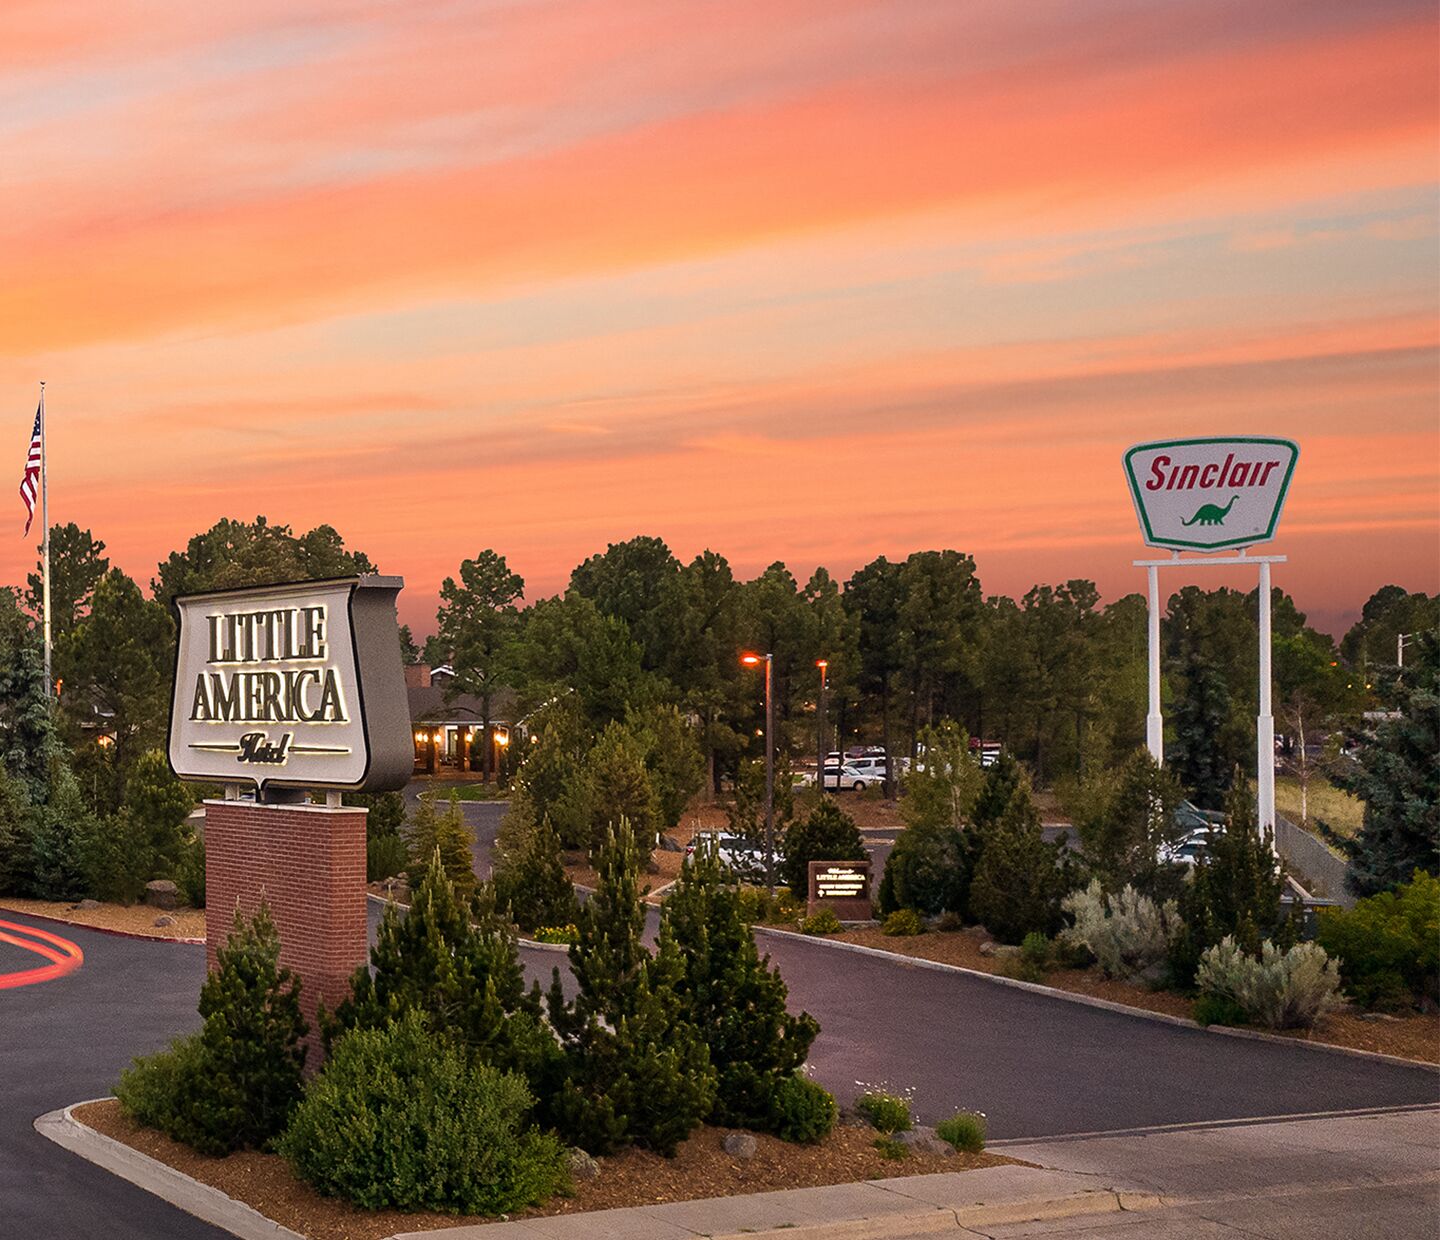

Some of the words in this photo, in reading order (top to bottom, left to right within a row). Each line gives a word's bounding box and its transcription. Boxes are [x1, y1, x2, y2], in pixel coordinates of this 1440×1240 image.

[1146, 453, 1280, 491] Sinclair
[206, 606, 325, 664] LITTLE
[189, 669, 348, 722] AMERICA
[237, 732, 290, 763] Hotel
